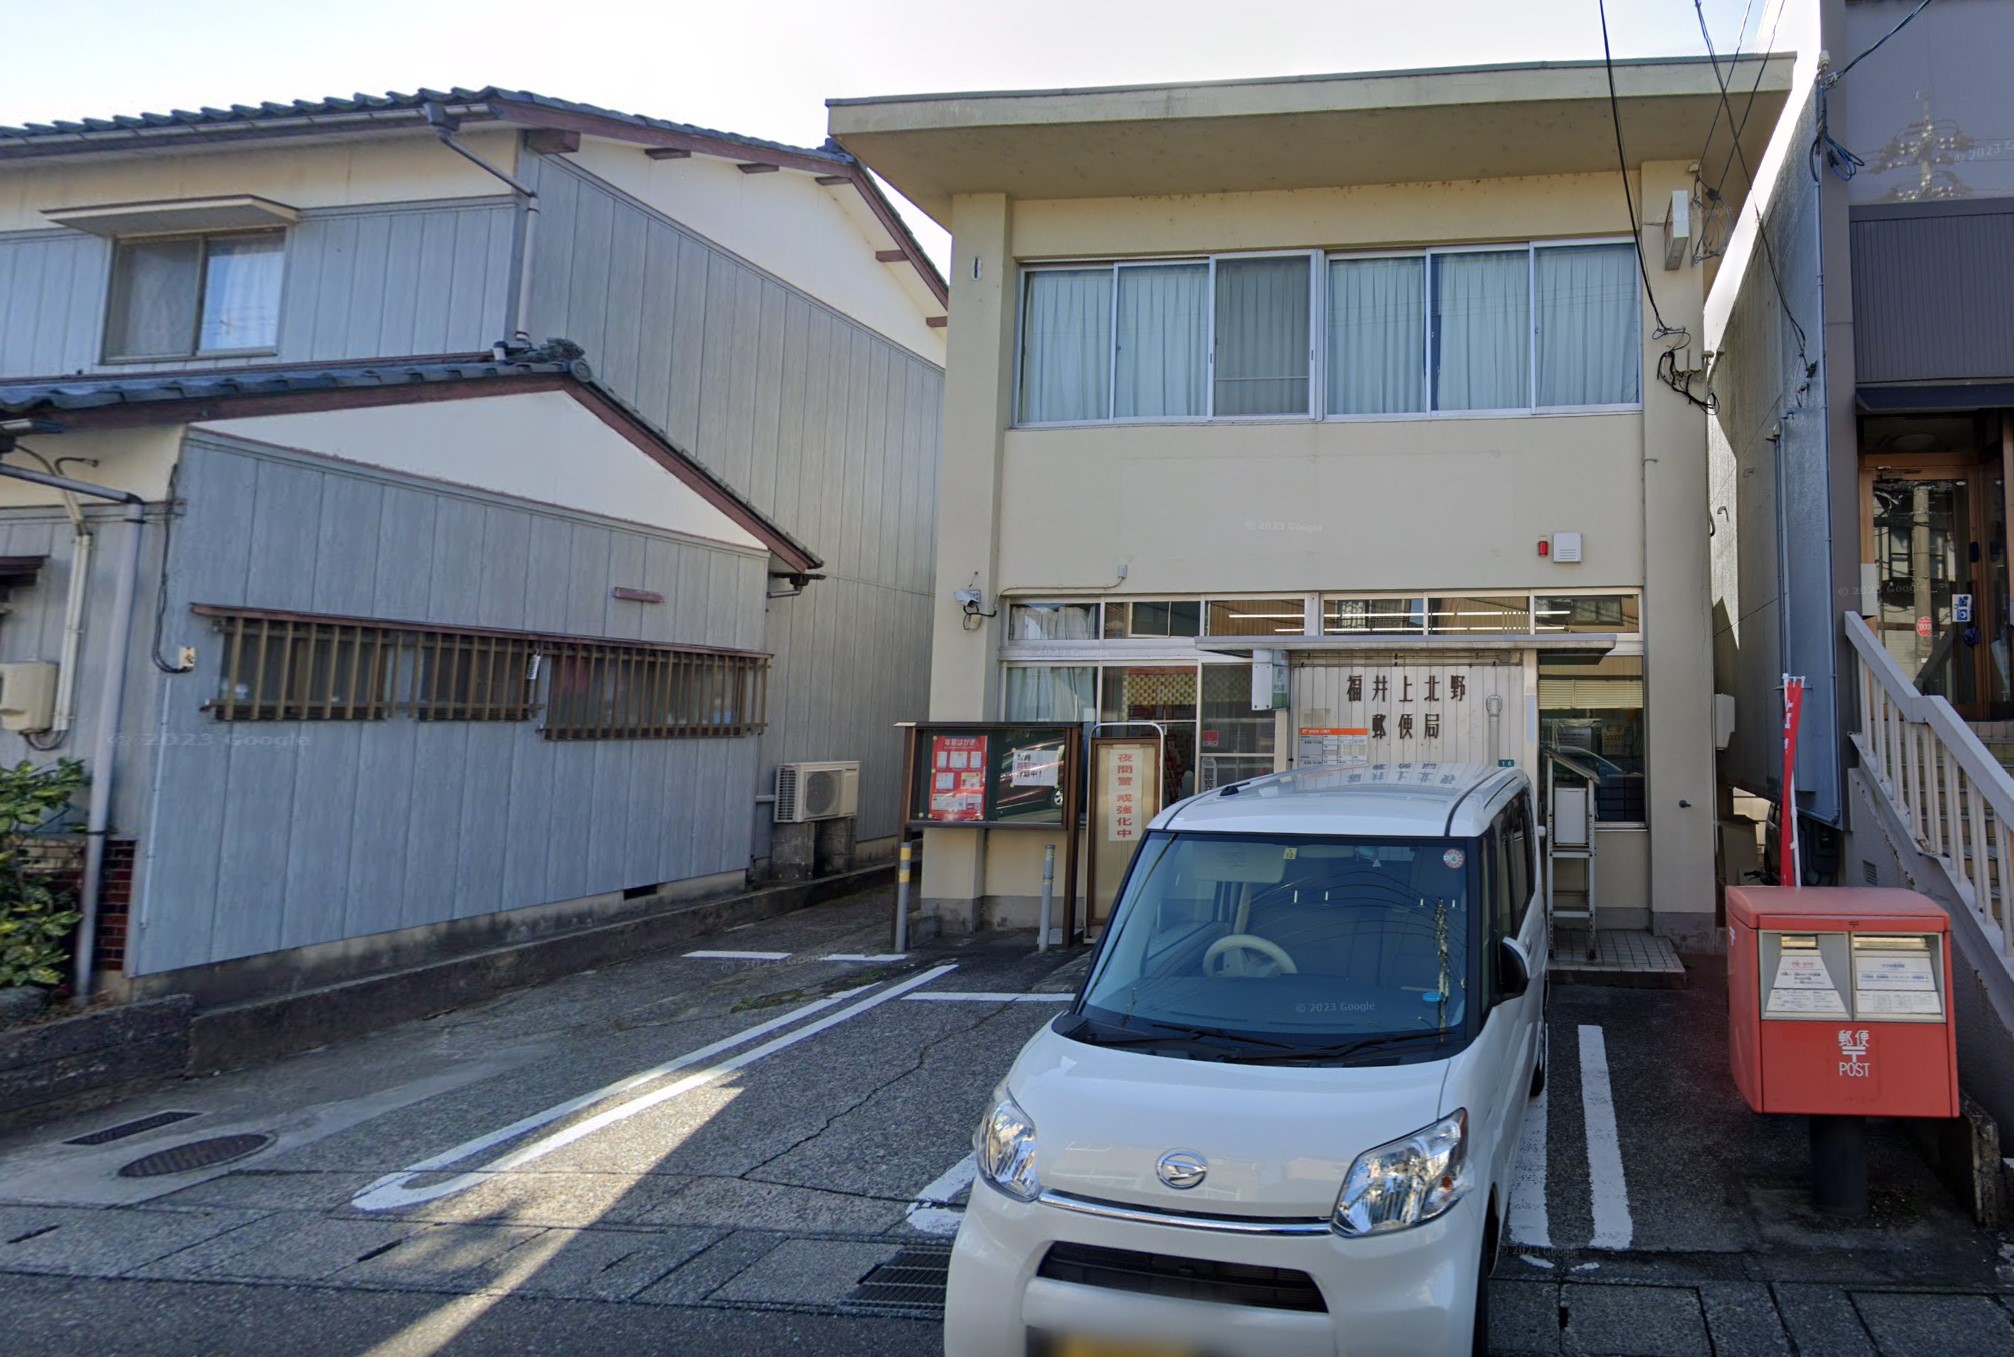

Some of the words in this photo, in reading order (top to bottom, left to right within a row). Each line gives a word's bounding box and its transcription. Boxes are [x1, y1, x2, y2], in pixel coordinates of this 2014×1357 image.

[1347, 674, 1466, 702] 福井上北野
[1371, 713, 1440, 740] 郵便局
[1838, 1029, 1870, 1047] 郵便
[1839, 1062, 1870, 1077] POST
